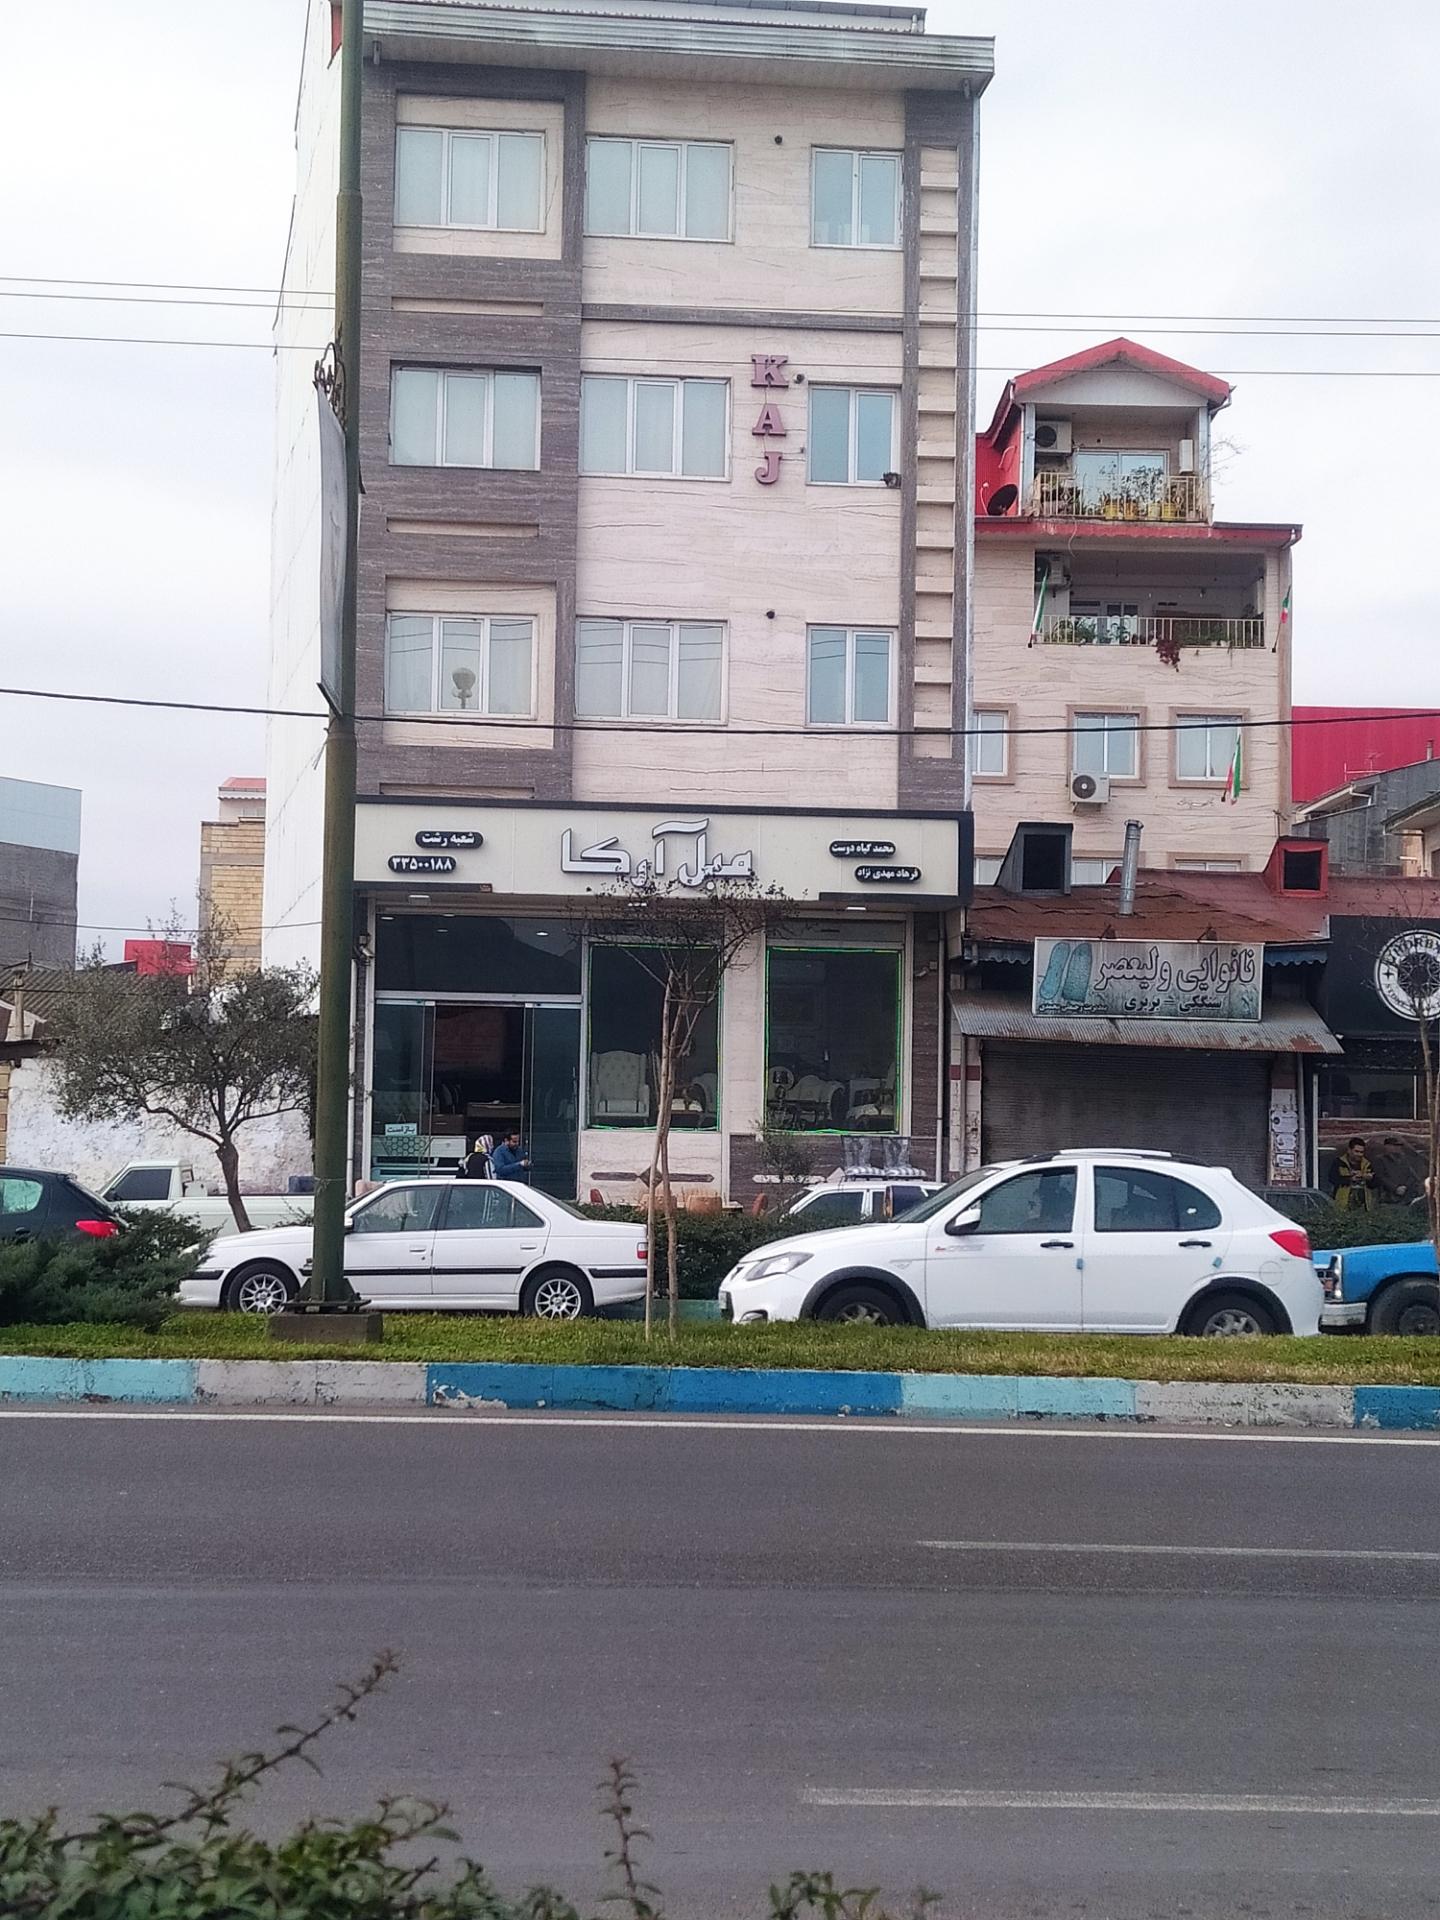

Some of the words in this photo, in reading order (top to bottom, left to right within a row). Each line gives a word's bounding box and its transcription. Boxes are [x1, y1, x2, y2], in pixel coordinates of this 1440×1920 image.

[751, 354, 789, 485] KAJ
[421, 833, 448, 846] رشت
[450, 832, 475, 846] شعبه
[873, 845, 894, 854] محمد
[392, 857, 453, 871] ۳۳۵۰۰۱۸۸
[677, 832, 753, 891] مبل
[896, 869, 918, 880] فرهاد
[1176, 946, 1256, 993] نانوایی
[1124, 996, 1161, 1012] بربری
[1179, 994, 1223, 1012] سنگکی
